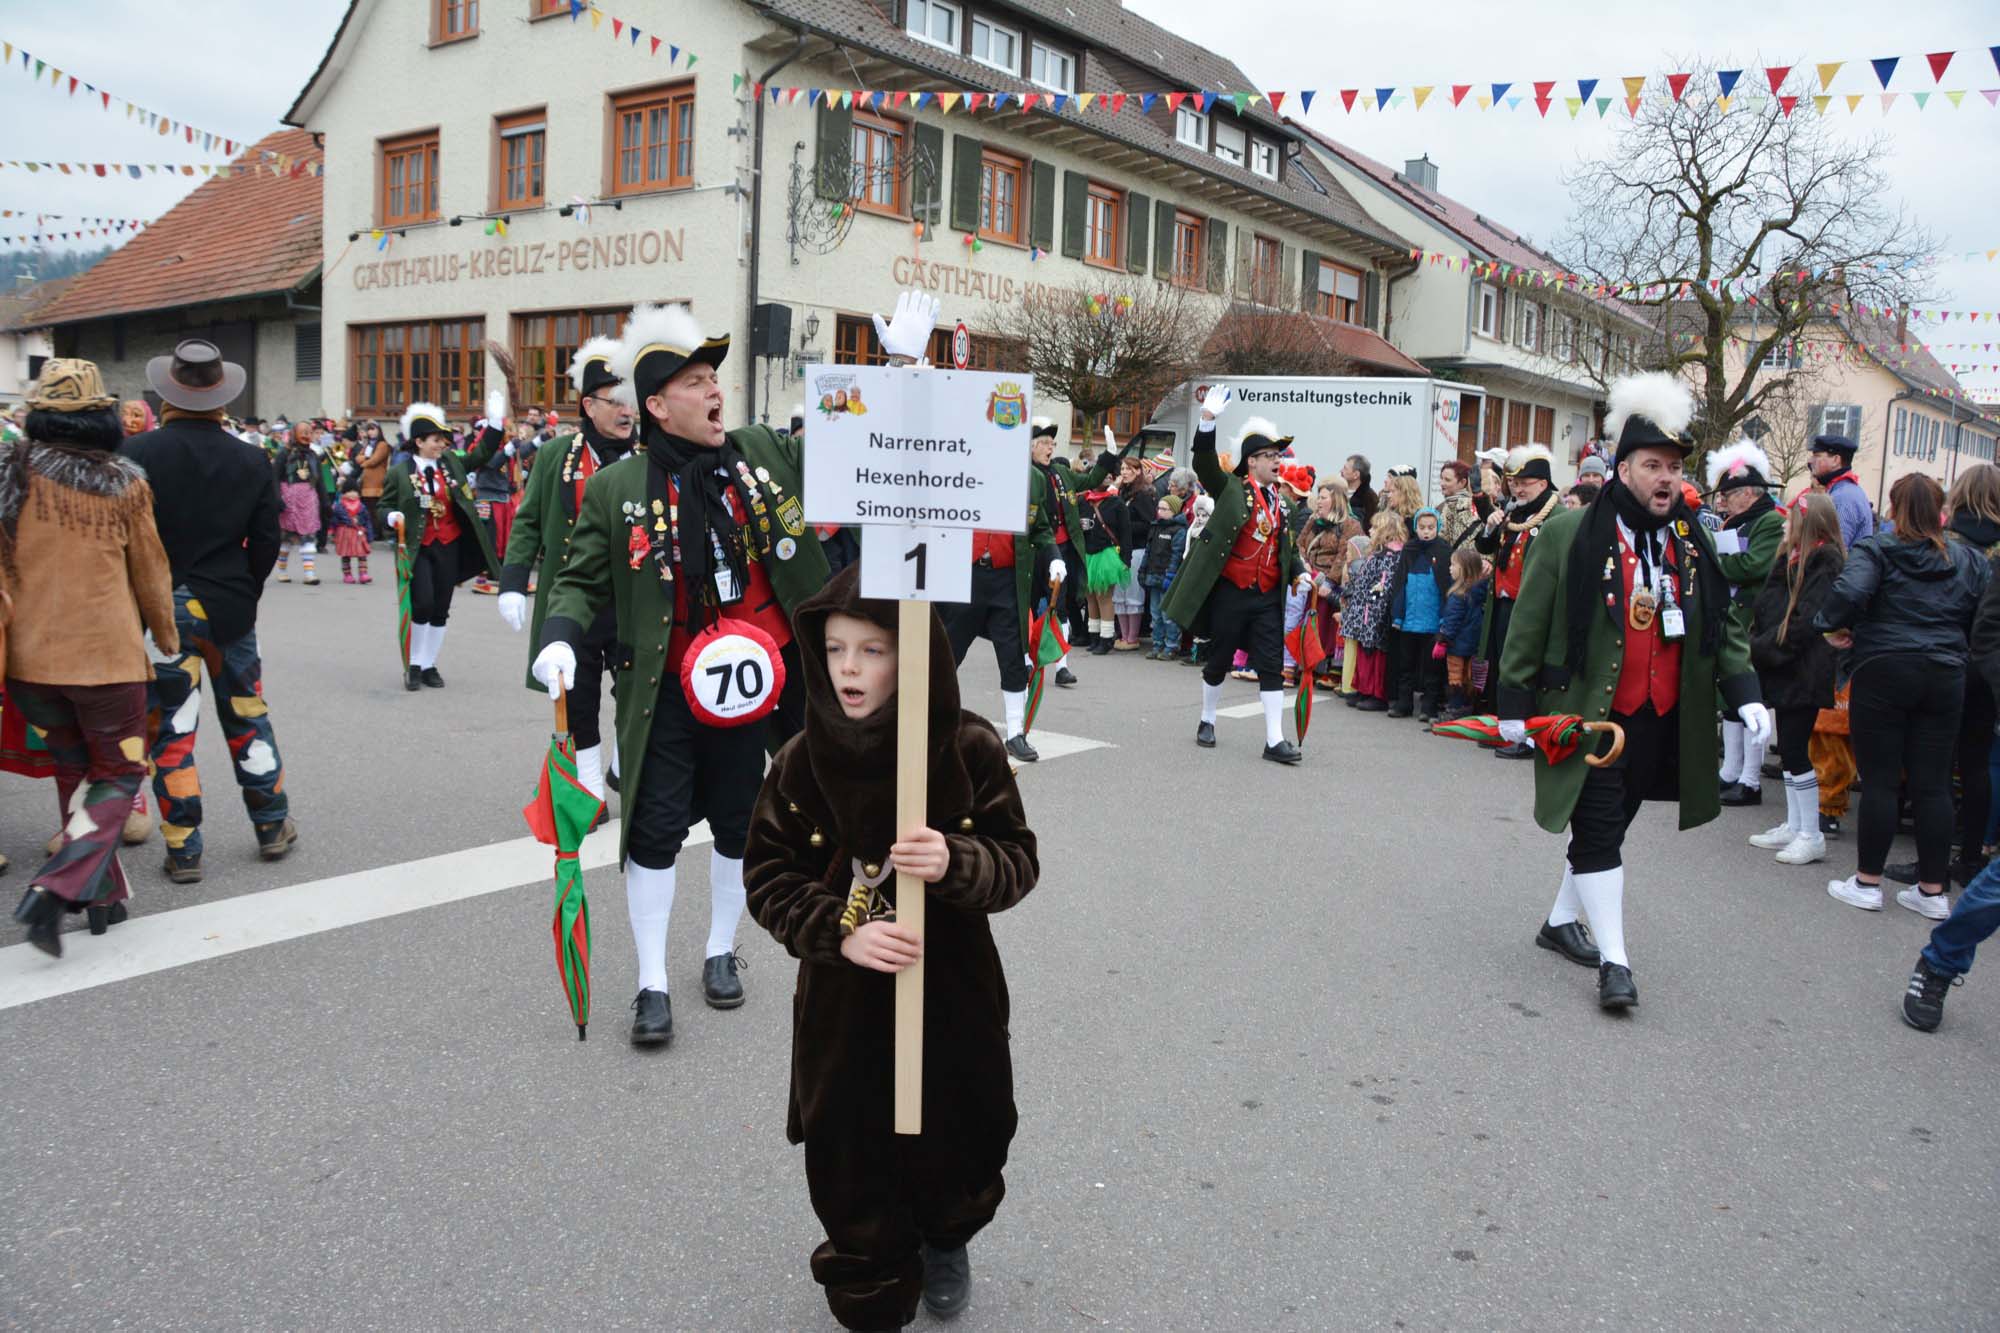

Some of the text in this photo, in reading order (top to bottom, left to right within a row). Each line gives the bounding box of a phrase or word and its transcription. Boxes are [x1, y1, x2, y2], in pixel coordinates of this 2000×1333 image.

[353, 228, 685, 291] GASTHAUS-KREUZ-PENSION
[957, 335, 966, 358] 30
[1238, 388, 1413, 407] Veranstaltungstechnik
[869, 432, 972, 456] Narrenrat,
[856, 467, 984, 489] Hexenhorde-
[856, 500, 981, 522] Simonsmoos
[904, 542, 927, 590] 1
[706, 659, 763, 705] 70
